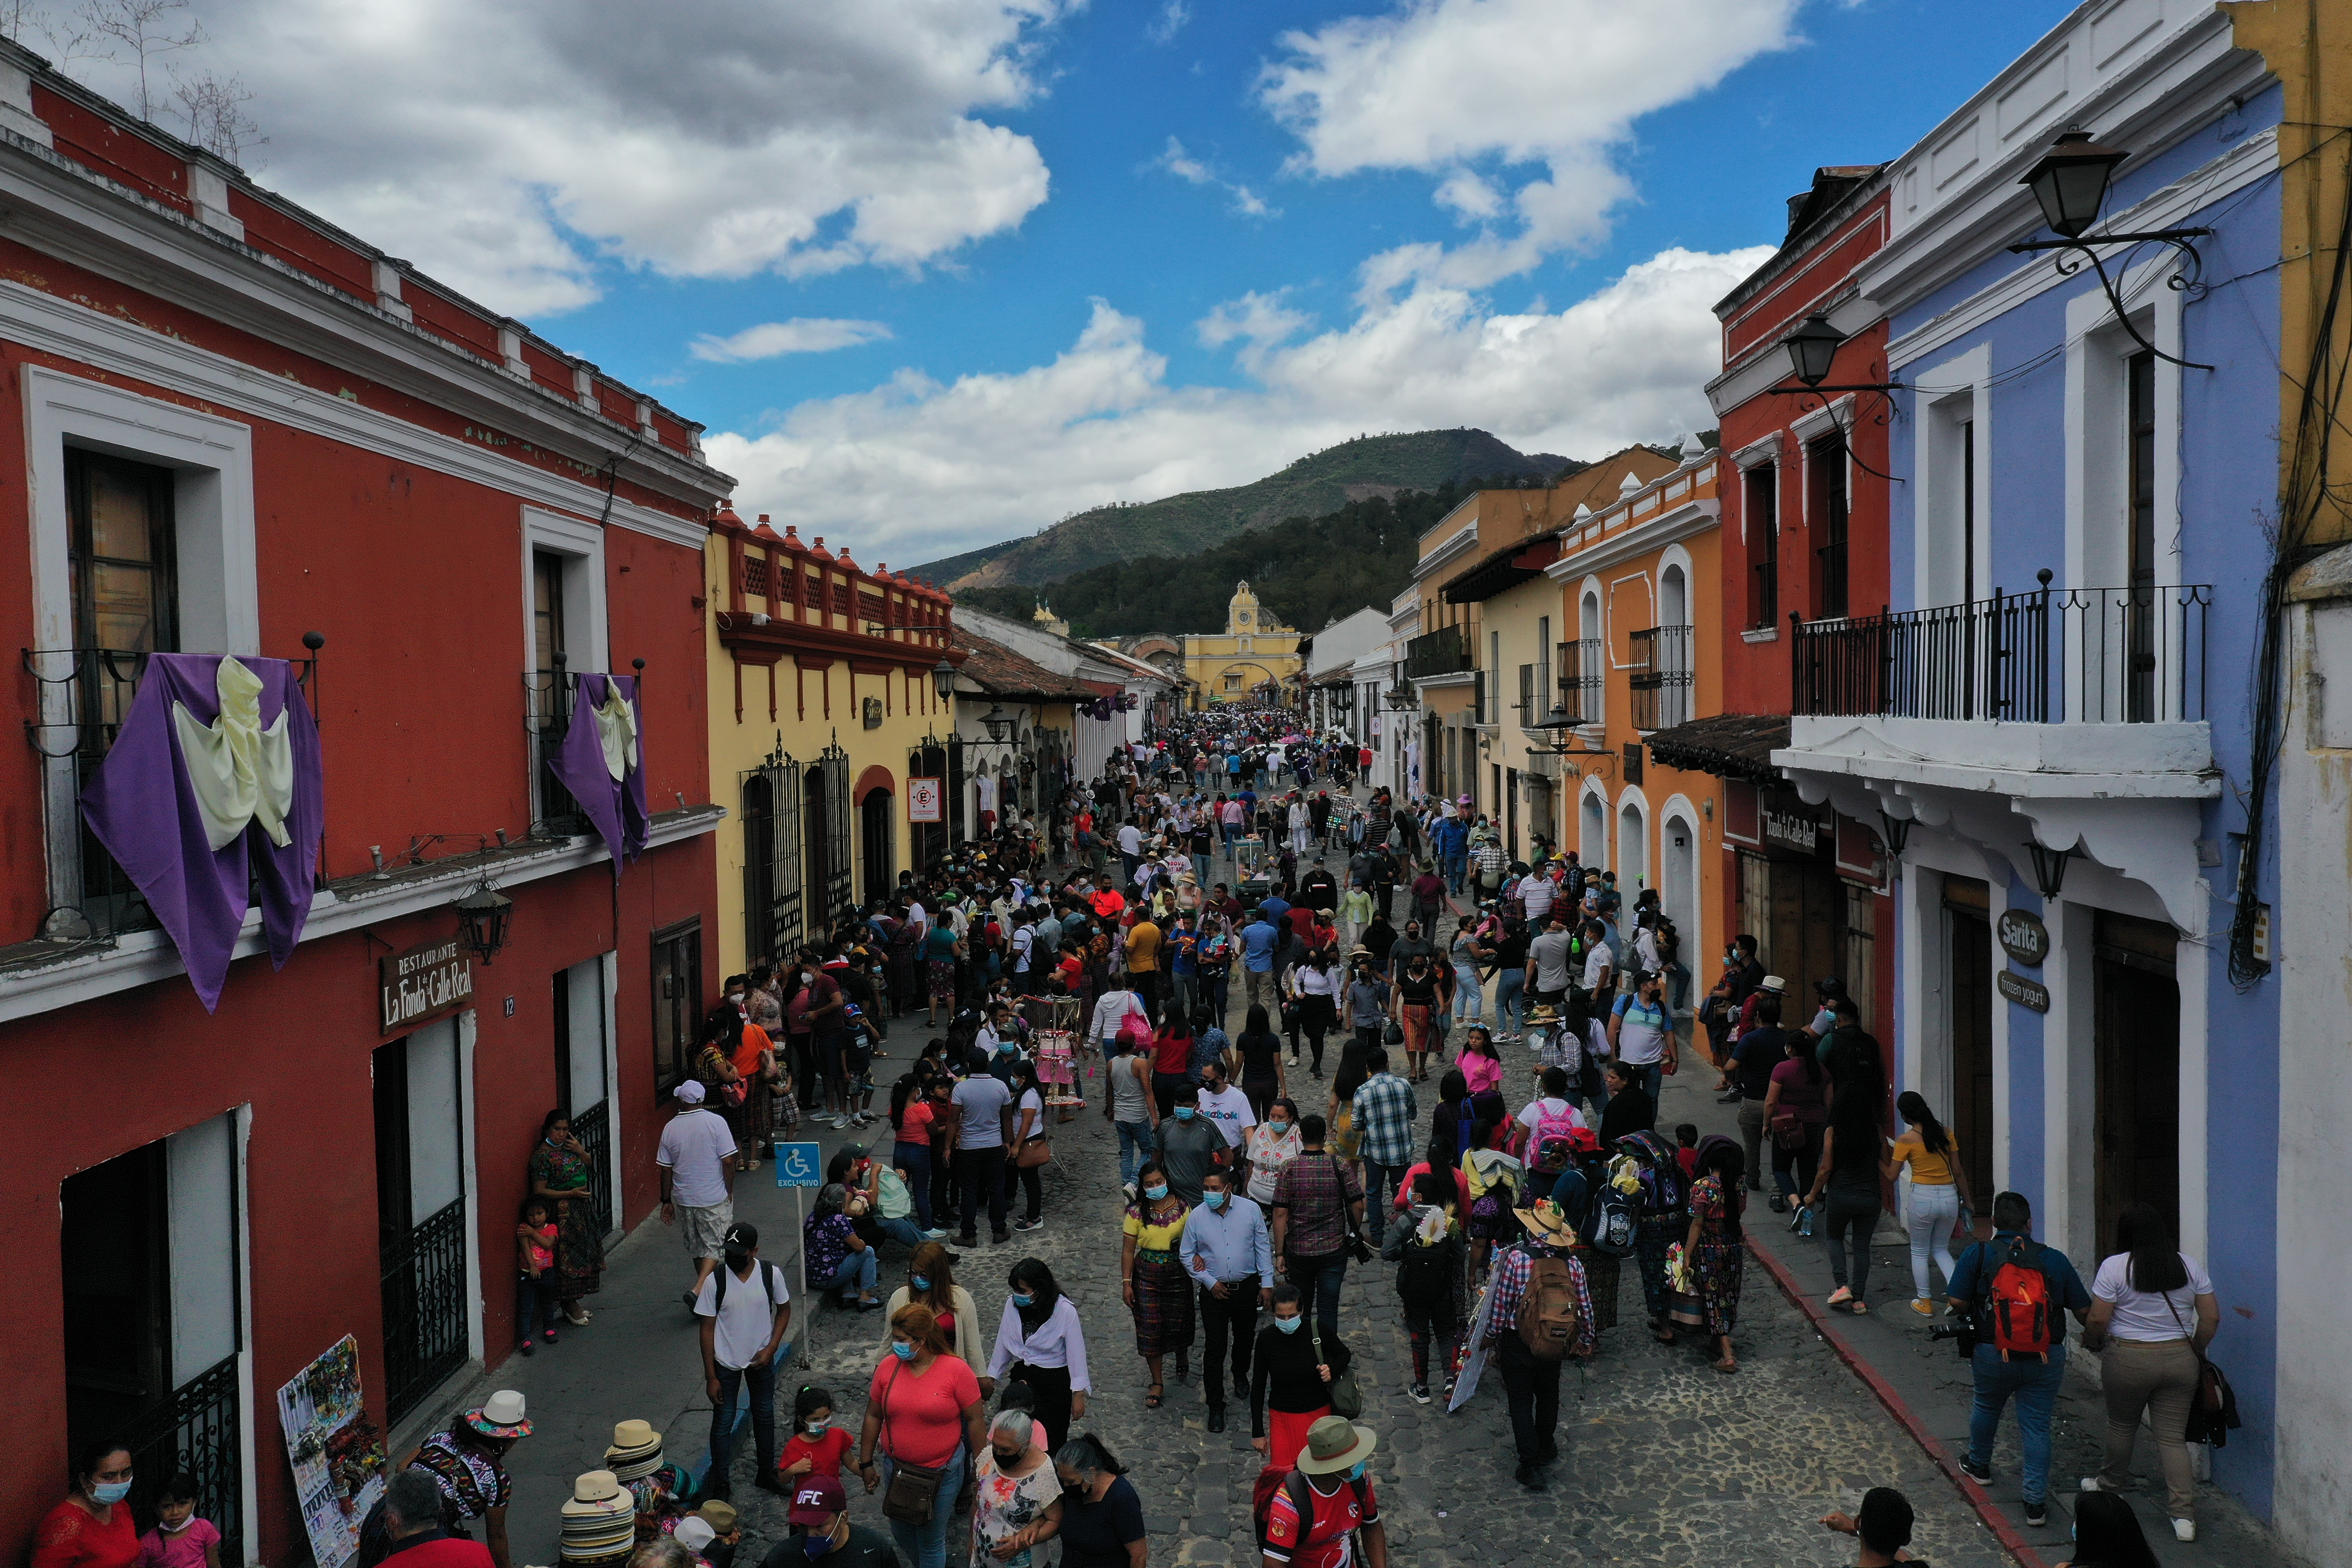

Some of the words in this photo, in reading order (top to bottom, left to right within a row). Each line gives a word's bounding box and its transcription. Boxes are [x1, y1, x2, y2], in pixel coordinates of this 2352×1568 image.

[1788, 815, 1802, 843] Calle
[1803, 820, 1816, 848] Real
[2003, 916, 2037, 952] Sarita
[399, 943, 456, 976] RESTAURANTE
[384, 986, 398, 1026] La
[399, 976, 426, 1020] Fonda
[430, 967, 452, 1006] Calle
[451, 959, 472, 998] Real
[2002, 976, 2021, 996] frozen
[2023, 986, 2043, 1005] yogurt
[506, 998, 513, 1017] 12
[796, 1490, 823, 1505] UFC
